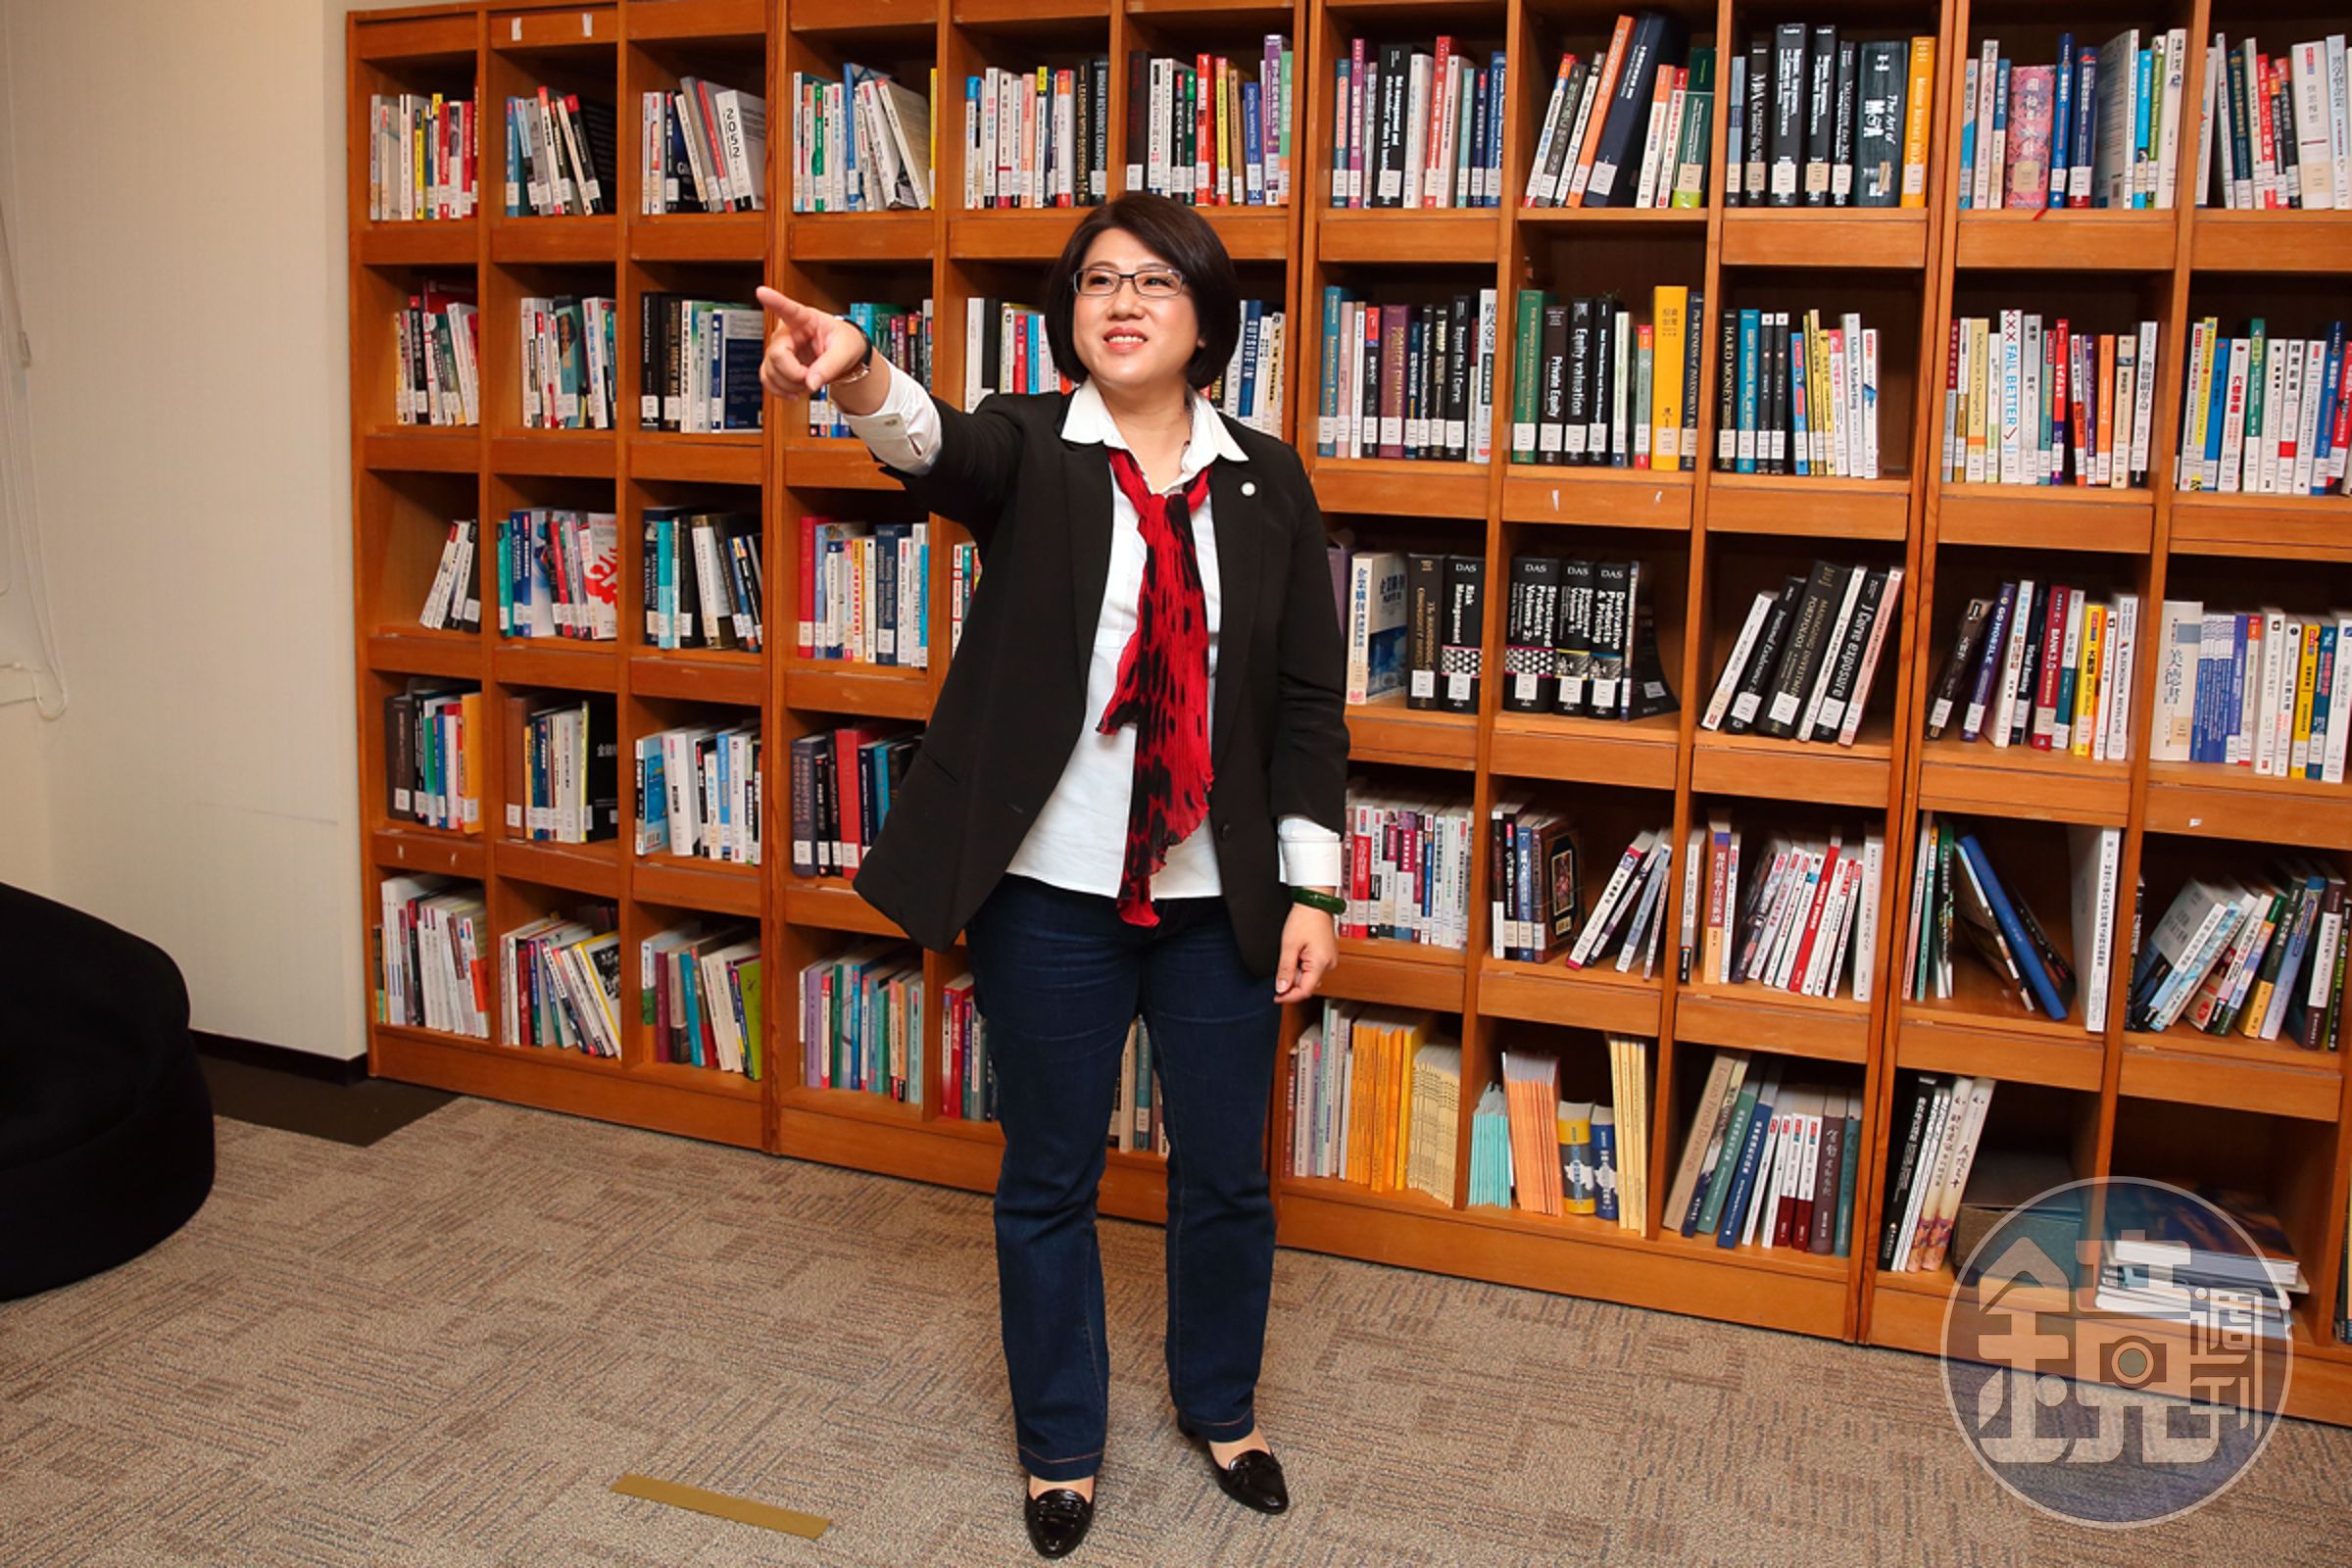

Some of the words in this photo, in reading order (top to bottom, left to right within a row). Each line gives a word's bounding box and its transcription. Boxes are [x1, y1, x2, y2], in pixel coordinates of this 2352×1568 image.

[1862, 98, 1886, 138] M&A
[1885, 94, 1897, 113] The
[723, 107, 741, 159] 2052
[1885, 115, 1895, 130] Art
[1243, 319, 1258, 364] OUTSIDE
[1452, 325, 1465, 354] Beyond
[1570, 327, 1589, 360] Equity
[1723, 325, 1734, 360] HARD
[2005, 344, 2018, 370] FAIL
[1243, 366, 1254, 378] IN
[1452, 355, 1464, 370] the
[1548, 355, 1564, 389] Private
[1451, 376, 1463, 404] Curve
[1568, 361, 1587, 416] valuation
[1722, 362, 1734, 403] MONEY
[1849, 368, 1858, 410] Marketing
[2005, 375, 2018, 425] BETTER
[1545, 388, 1562, 418] Equity
[1455, 564, 1478, 573] DAS
[1524, 564, 1547, 573] DAS
[1567, 565, 1589, 576] DAS
[1600, 569, 1624, 579] DAS
[1463, 583, 1475, 606] Risk
[1522, 584, 1536, 627] Volume
[1533, 584, 1546, 636] Products
[1566, 586, 1580, 621] Volume
[1574, 587, 1588, 629] Products
[1596, 588, 1606, 599] &
[1448, 582, 1466, 644] Management
[1542, 584, 1557, 648] Structured
[1580, 587, 1595, 638] Structured
[1591, 602, 1605, 644] Pricing
[1601, 590, 1616, 644] Products
[1611, 590, 1626, 650] Derivative
[1847, 610, 1872, 644] Curve
[1982, 620, 2004, 665] MOBILE
[1829, 640, 1862, 700] exposure
[2116, 650, 2129, 694] BLOCKCHAIN
